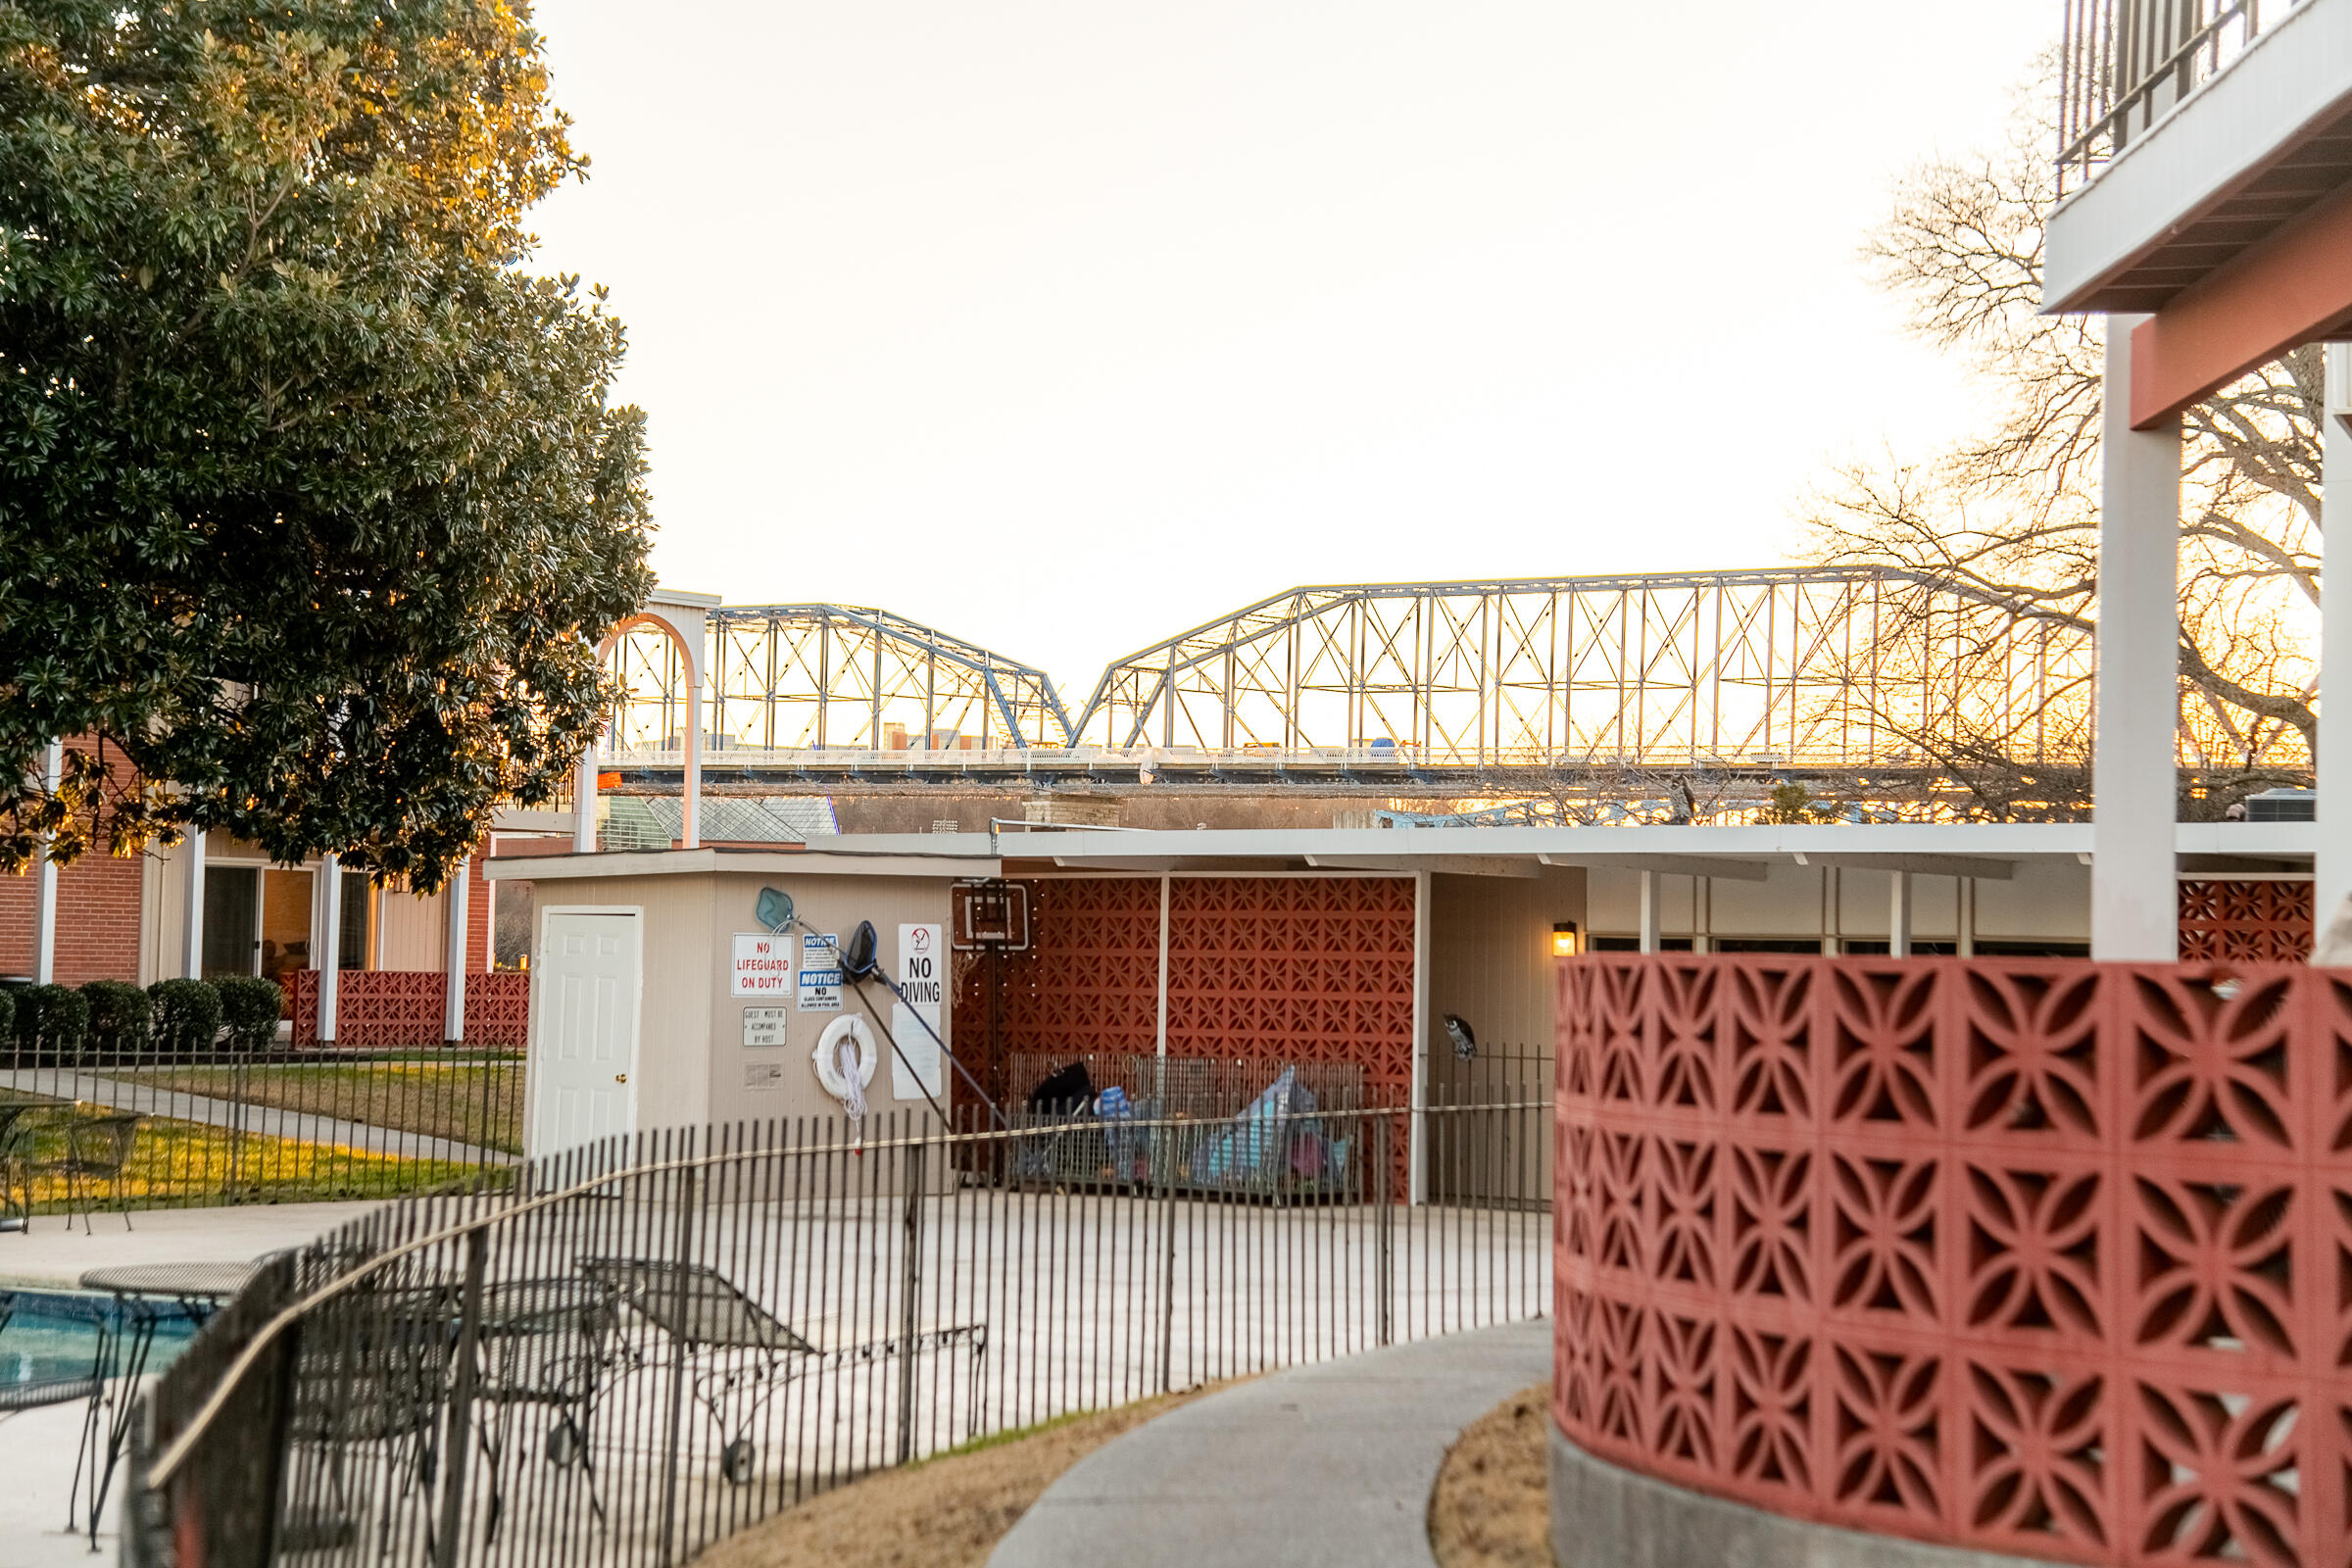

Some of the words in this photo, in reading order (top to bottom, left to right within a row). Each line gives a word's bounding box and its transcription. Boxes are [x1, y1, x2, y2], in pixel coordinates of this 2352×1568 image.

[757, 942, 770, 953] NO
[737, 959, 788, 970] LIFEGUARD
[909, 957, 931, 978] NO
[741, 977, 754, 988] ON
[759, 977, 783, 988] DUTY
[801, 973, 840, 984] NOTICE
[901, 981, 939, 1002] DIVING
[745, 1010, 759, 1019] GUEST
[764, 1010, 776, 1018] MUST
[754, 1035, 761, 1043] BY
[762, 1035, 774, 1043] HOST
